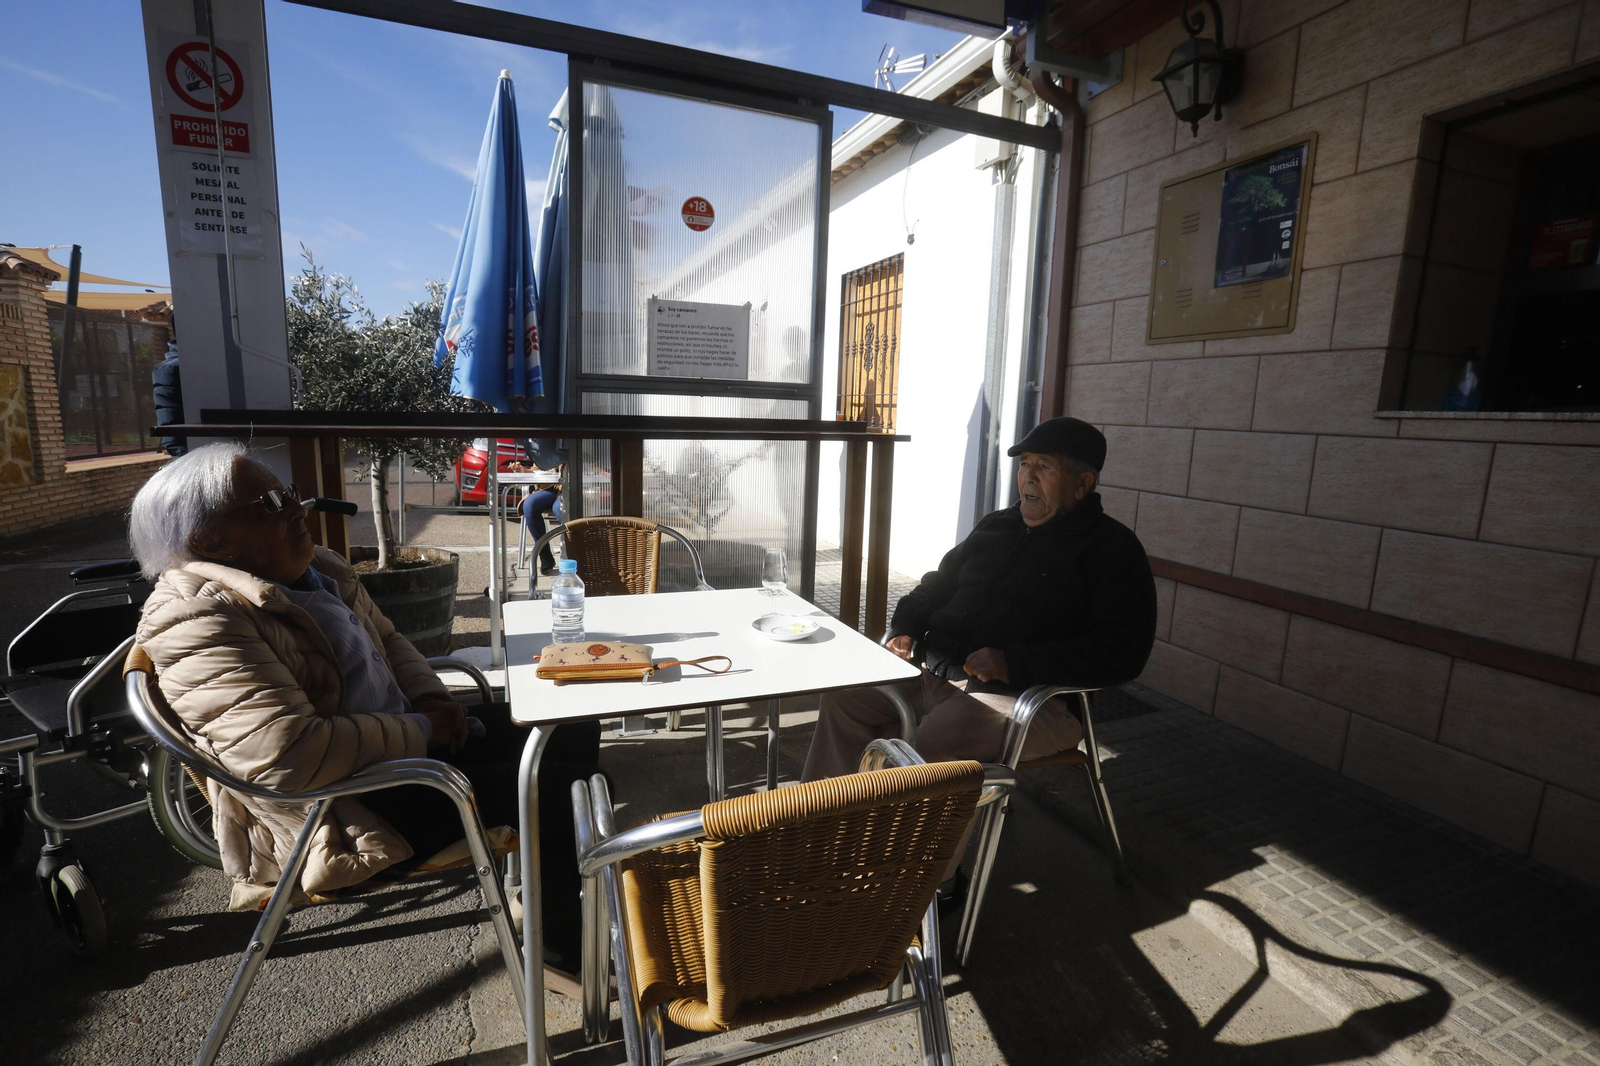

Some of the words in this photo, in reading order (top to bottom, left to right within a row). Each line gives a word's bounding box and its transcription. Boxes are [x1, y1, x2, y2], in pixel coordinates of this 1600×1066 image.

[173, 120, 246, 137] PROHIIDO
[189, 133, 234, 147] FUMR
[1269, 158, 1299, 174] Bonsái
[227, 181, 239, 189] AL
[195, 208, 224, 217] ANTE
[232, 211, 245, 219] DE
